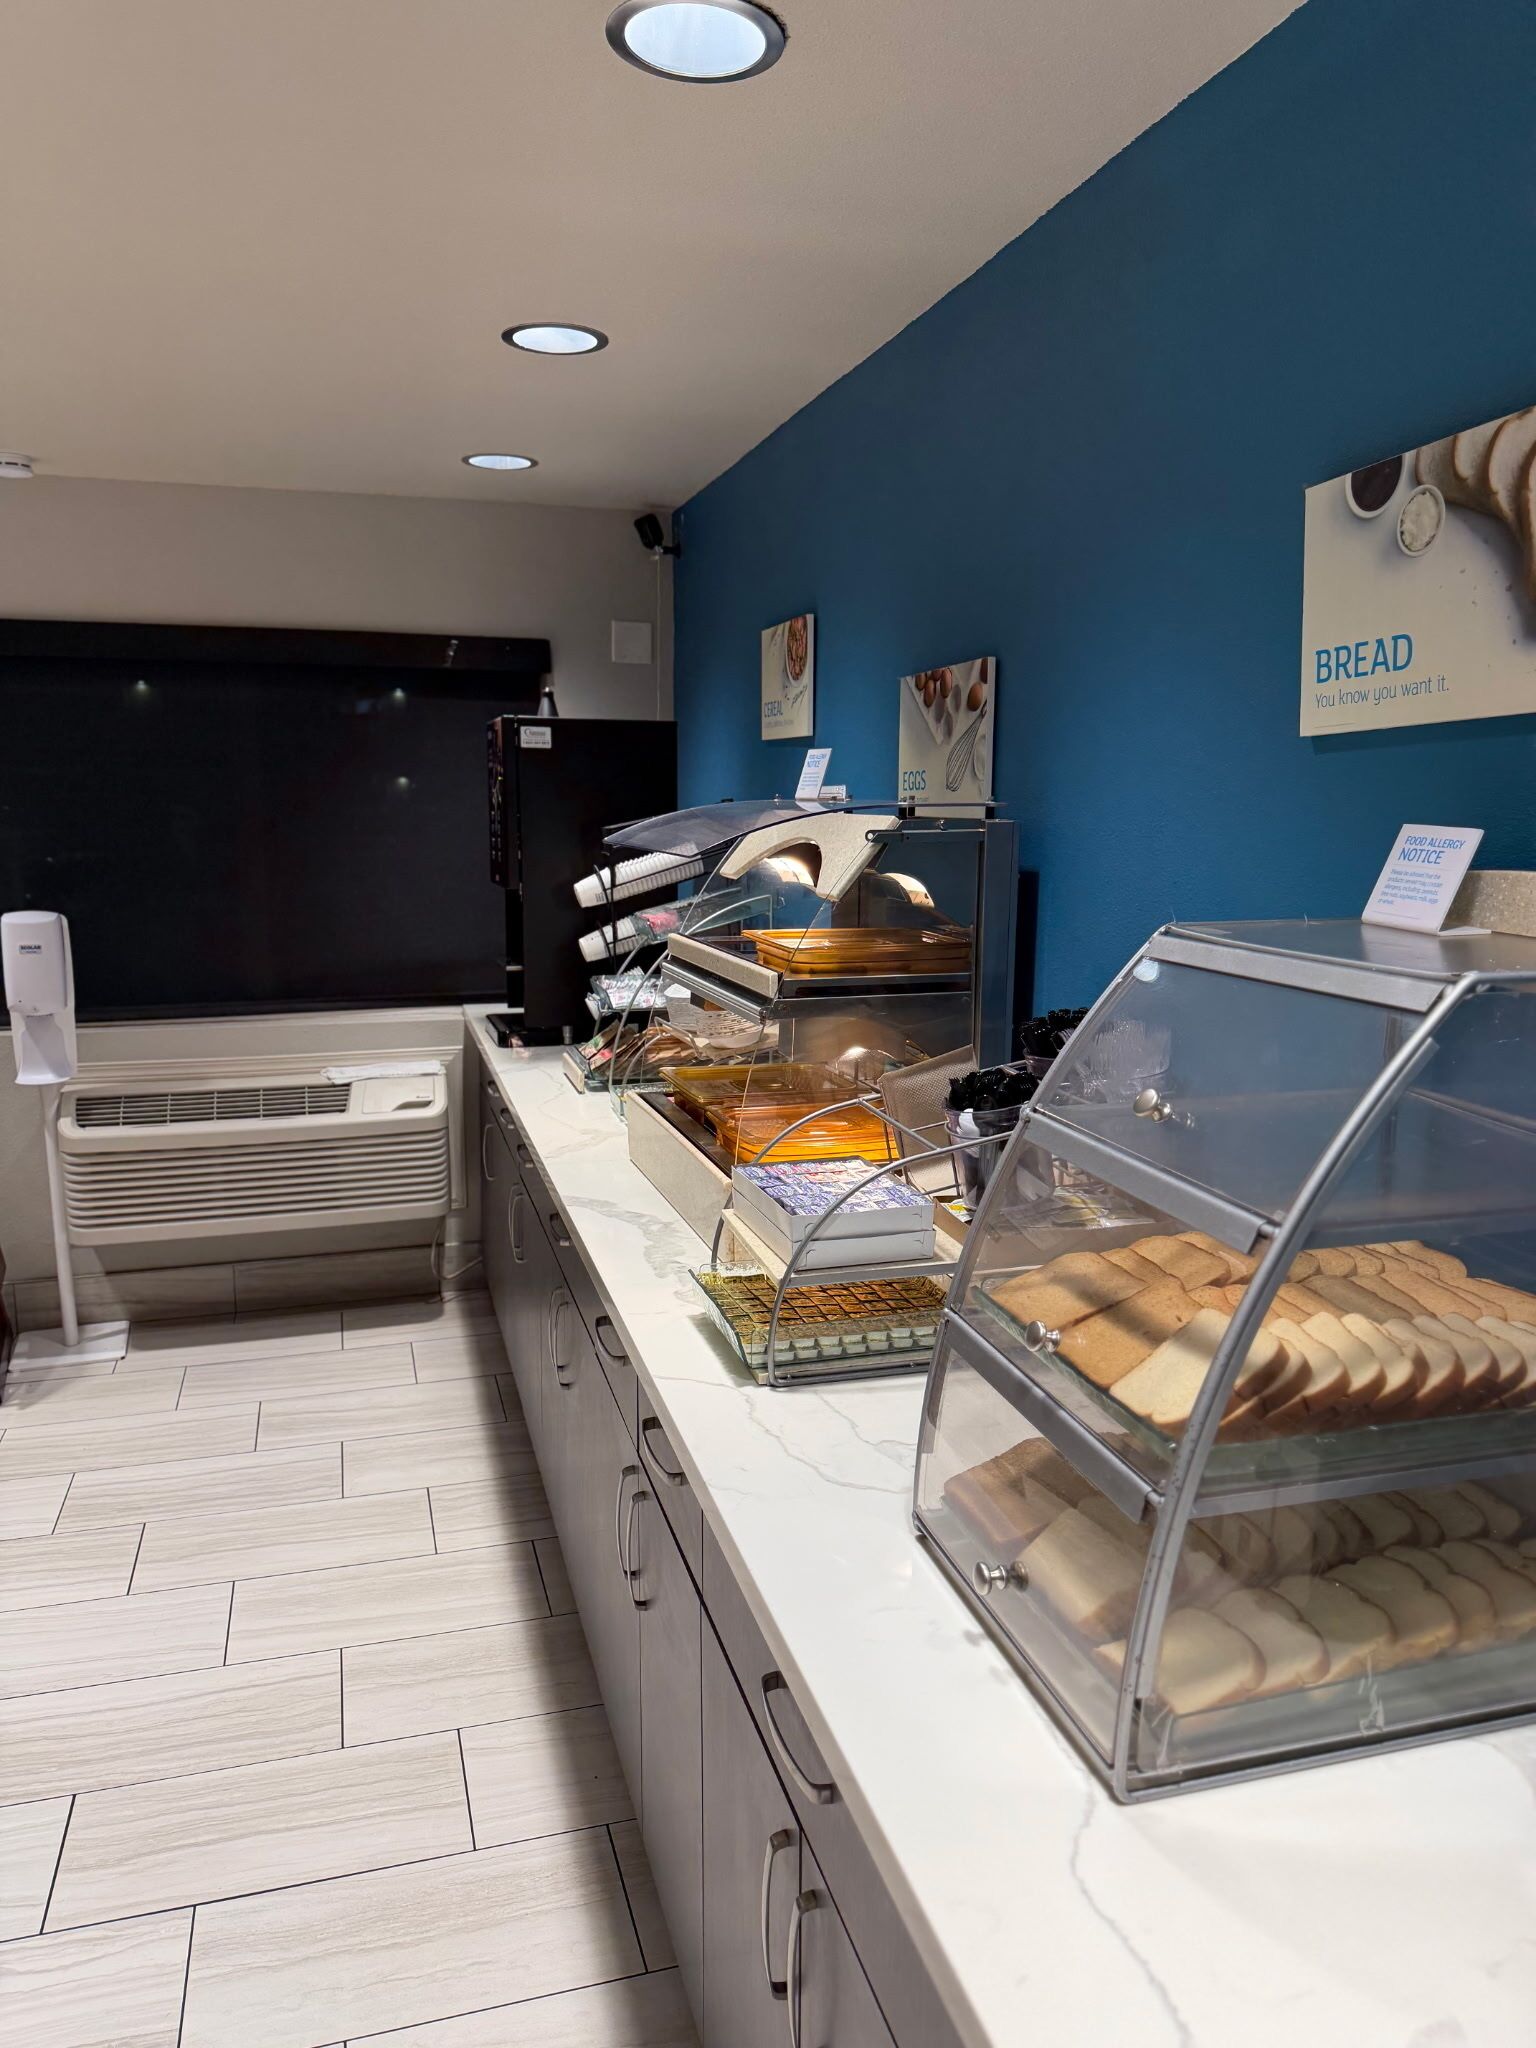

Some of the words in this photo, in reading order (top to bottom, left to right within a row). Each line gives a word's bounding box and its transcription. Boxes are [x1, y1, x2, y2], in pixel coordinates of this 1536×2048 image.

[1315, 633, 1413, 684] BREAD
[1315, 692, 1336, 709] You
[1338, 688, 1370, 705] know
[1373, 684, 1397, 706] you
[1400, 676, 1433, 696] want
[1437, 674, 1449, 692] it.
[763, 699, 783, 718] CEREAL
[903, 770, 926, 791] EGGS
[1404, 835, 1428, 847] FOOD
[1428, 837, 1466, 850] ALLERGY
[1398, 847, 1445, 865] NOTICE
